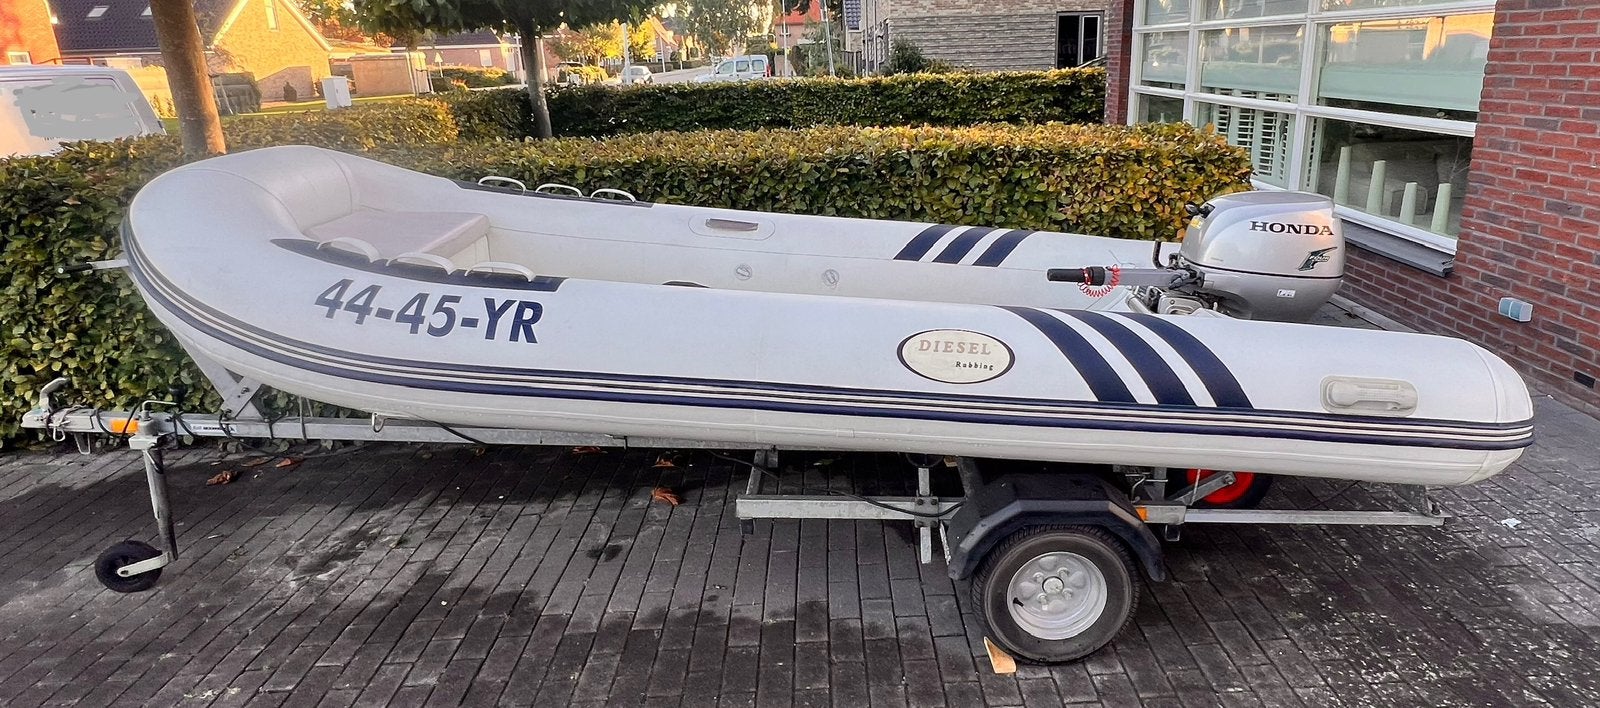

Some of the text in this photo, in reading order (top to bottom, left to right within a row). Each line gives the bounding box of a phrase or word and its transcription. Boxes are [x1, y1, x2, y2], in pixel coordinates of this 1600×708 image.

[1249, 221, 1334, 236] HONDA
[315, 278, 544, 344] 44-45-YR
[919, 339, 992, 355] DIESEL
